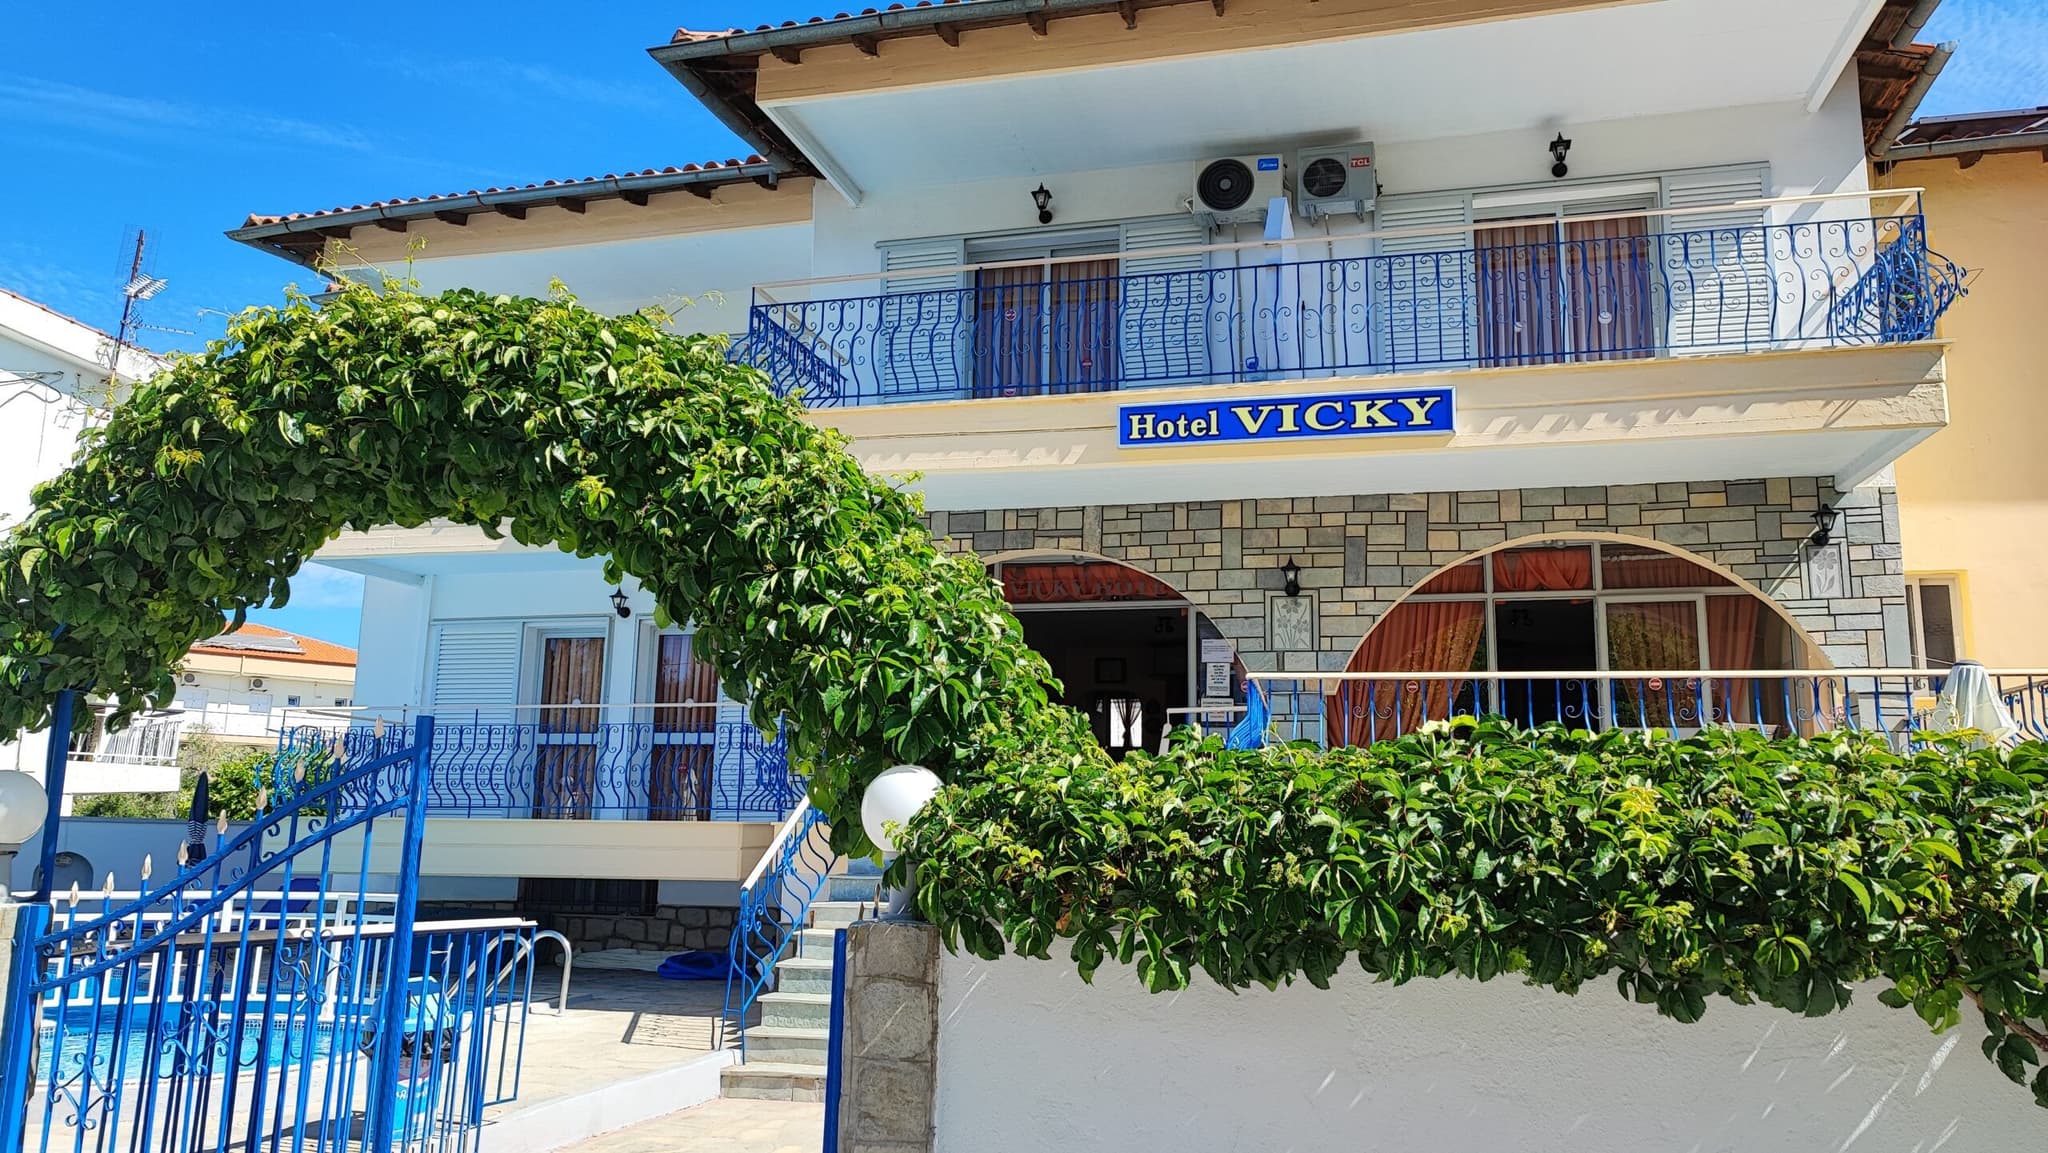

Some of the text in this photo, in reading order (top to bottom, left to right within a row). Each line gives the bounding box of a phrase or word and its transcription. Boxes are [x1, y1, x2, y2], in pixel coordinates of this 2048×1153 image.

[1351, 158, 1369, 167] TCL
[1128, 396, 1441, 440] Hotel VICKY
